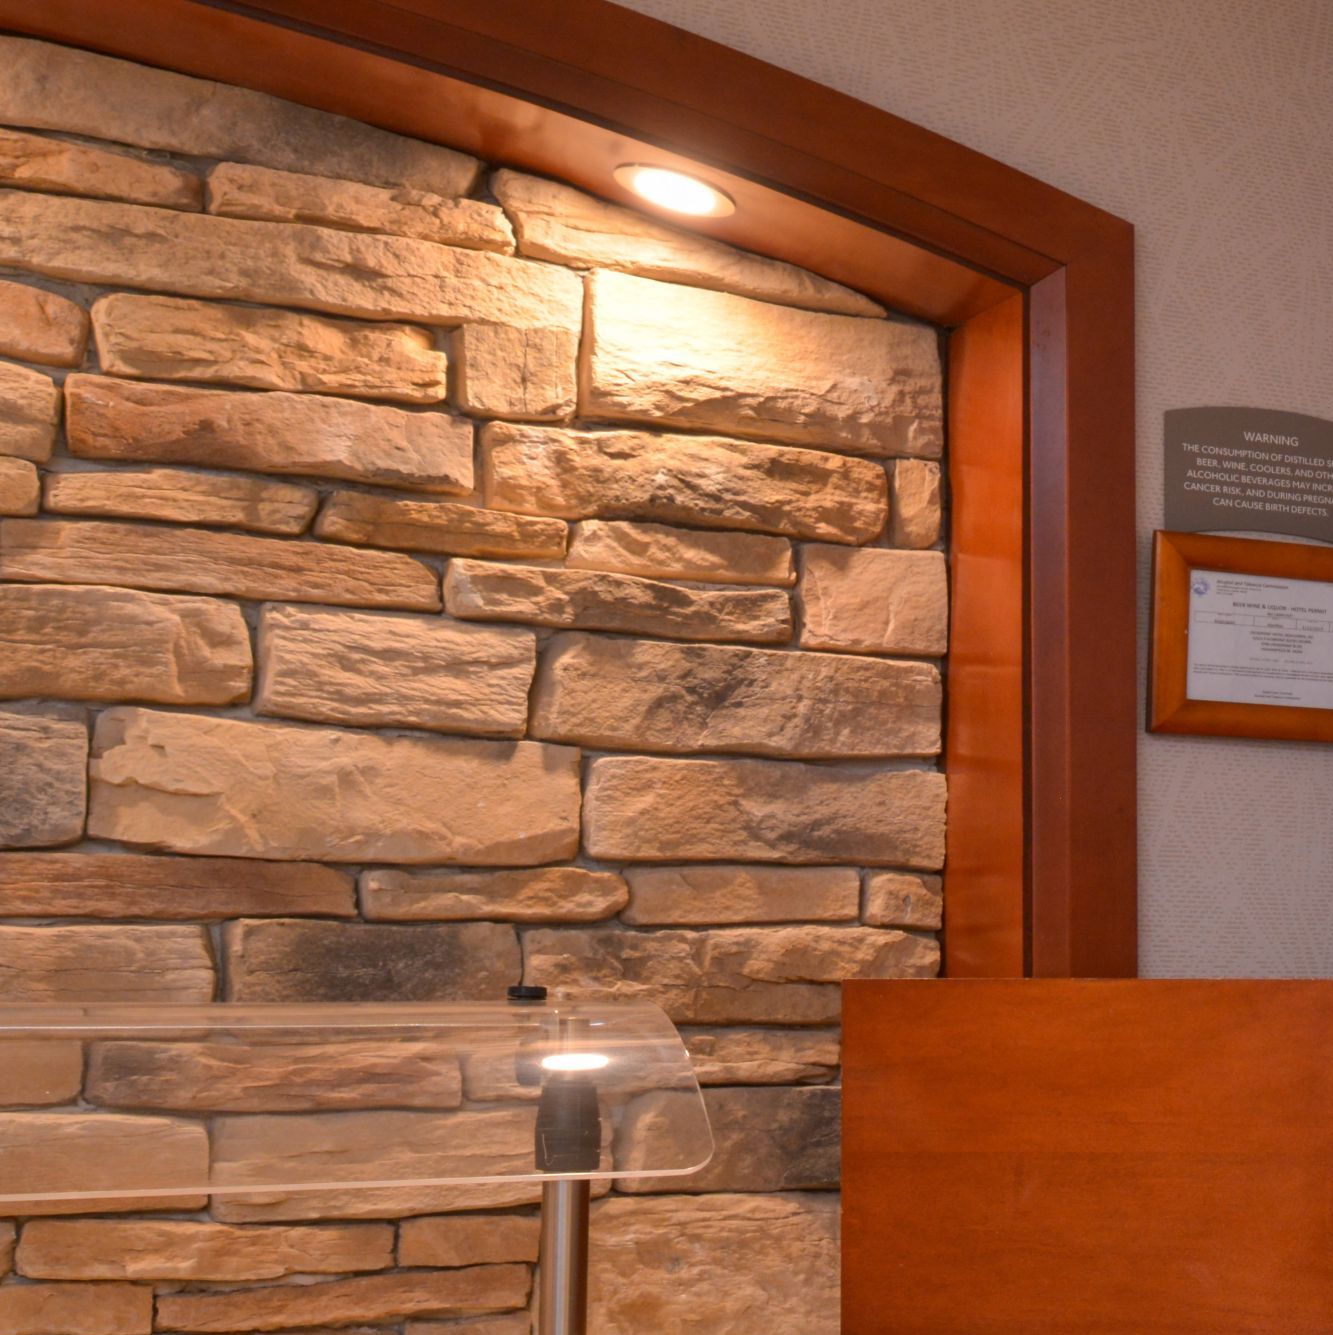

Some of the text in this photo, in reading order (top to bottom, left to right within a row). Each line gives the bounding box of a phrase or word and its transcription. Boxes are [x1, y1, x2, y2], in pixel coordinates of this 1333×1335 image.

[1243, 431, 1299, 447] WARNING
[1182, 443, 1199, 452] THE
[1201, 445, 1269, 460] CONSUMPTION
[1270, 453, 1283, 462] OF
[1284, 454, 1325, 467] DISTILLED
[1186, 469, 1240, 482] ALCOHOLIC
[1241, 475, 1291, 488] BEVERAGES
[1292, 480, 1311, 490] MAY
[1294, 469, 1314, 479] AND
[1183, 481, 1221, 493] CANCER
[1246, 488, 1266, 498] AND
[1266, 490, 1301, 502] DURING
[1212, 497, 1233, 507] CAN
[1234, 499, 1264, 510] CAUSE
[1265, 503, 1290, 513] BIRTH
